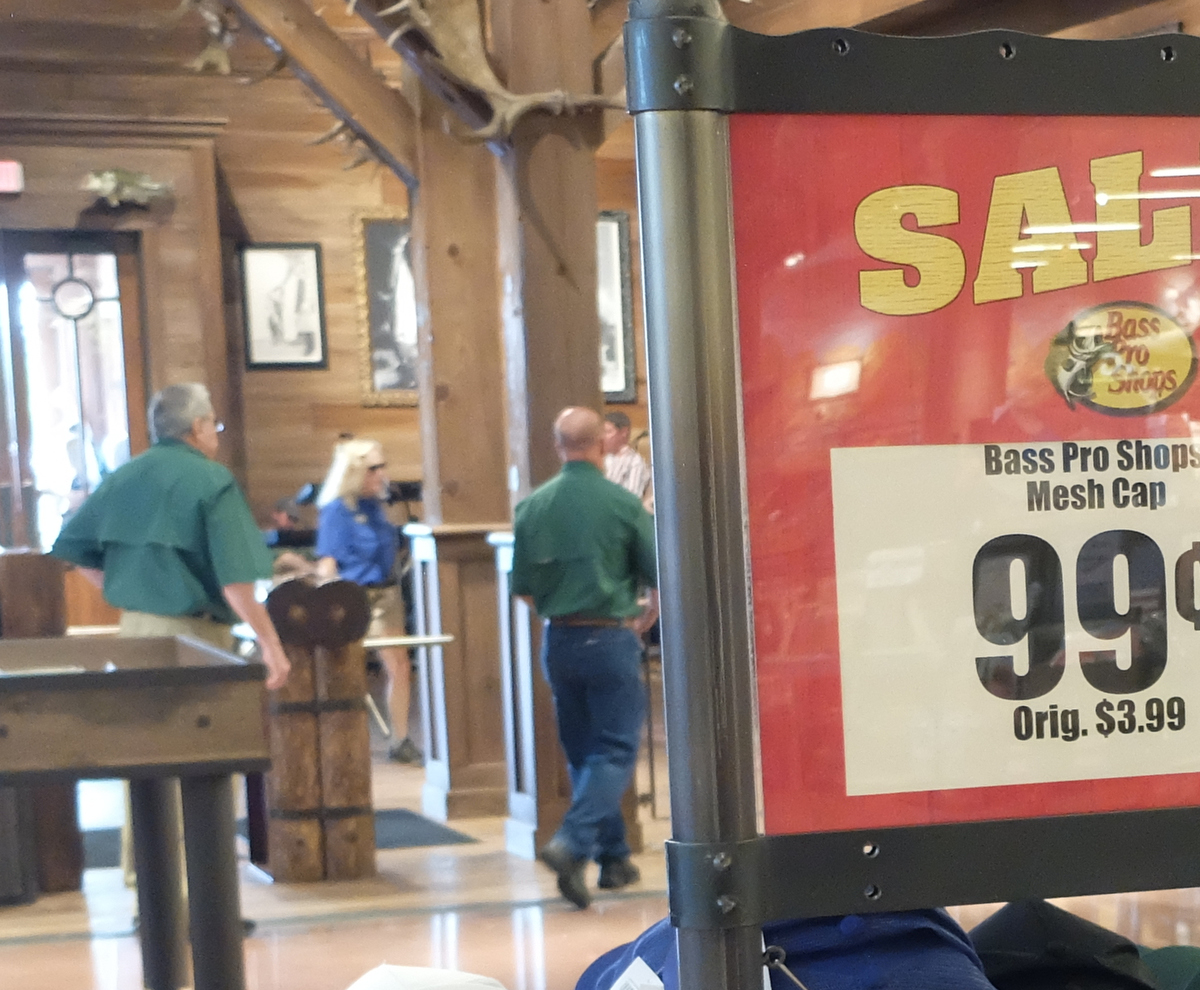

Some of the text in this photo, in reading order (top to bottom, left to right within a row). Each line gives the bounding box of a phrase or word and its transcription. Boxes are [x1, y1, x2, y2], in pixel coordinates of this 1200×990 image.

[1103, 310, 1161, 342] Bass
[983, 444, 1055, 475] Bass
[1062, 441, 1109, 473] Pro
[1026, 477, 1167, 512] Mesh Cap
[1013, 696, 1186, 742] Orig. $3.99
